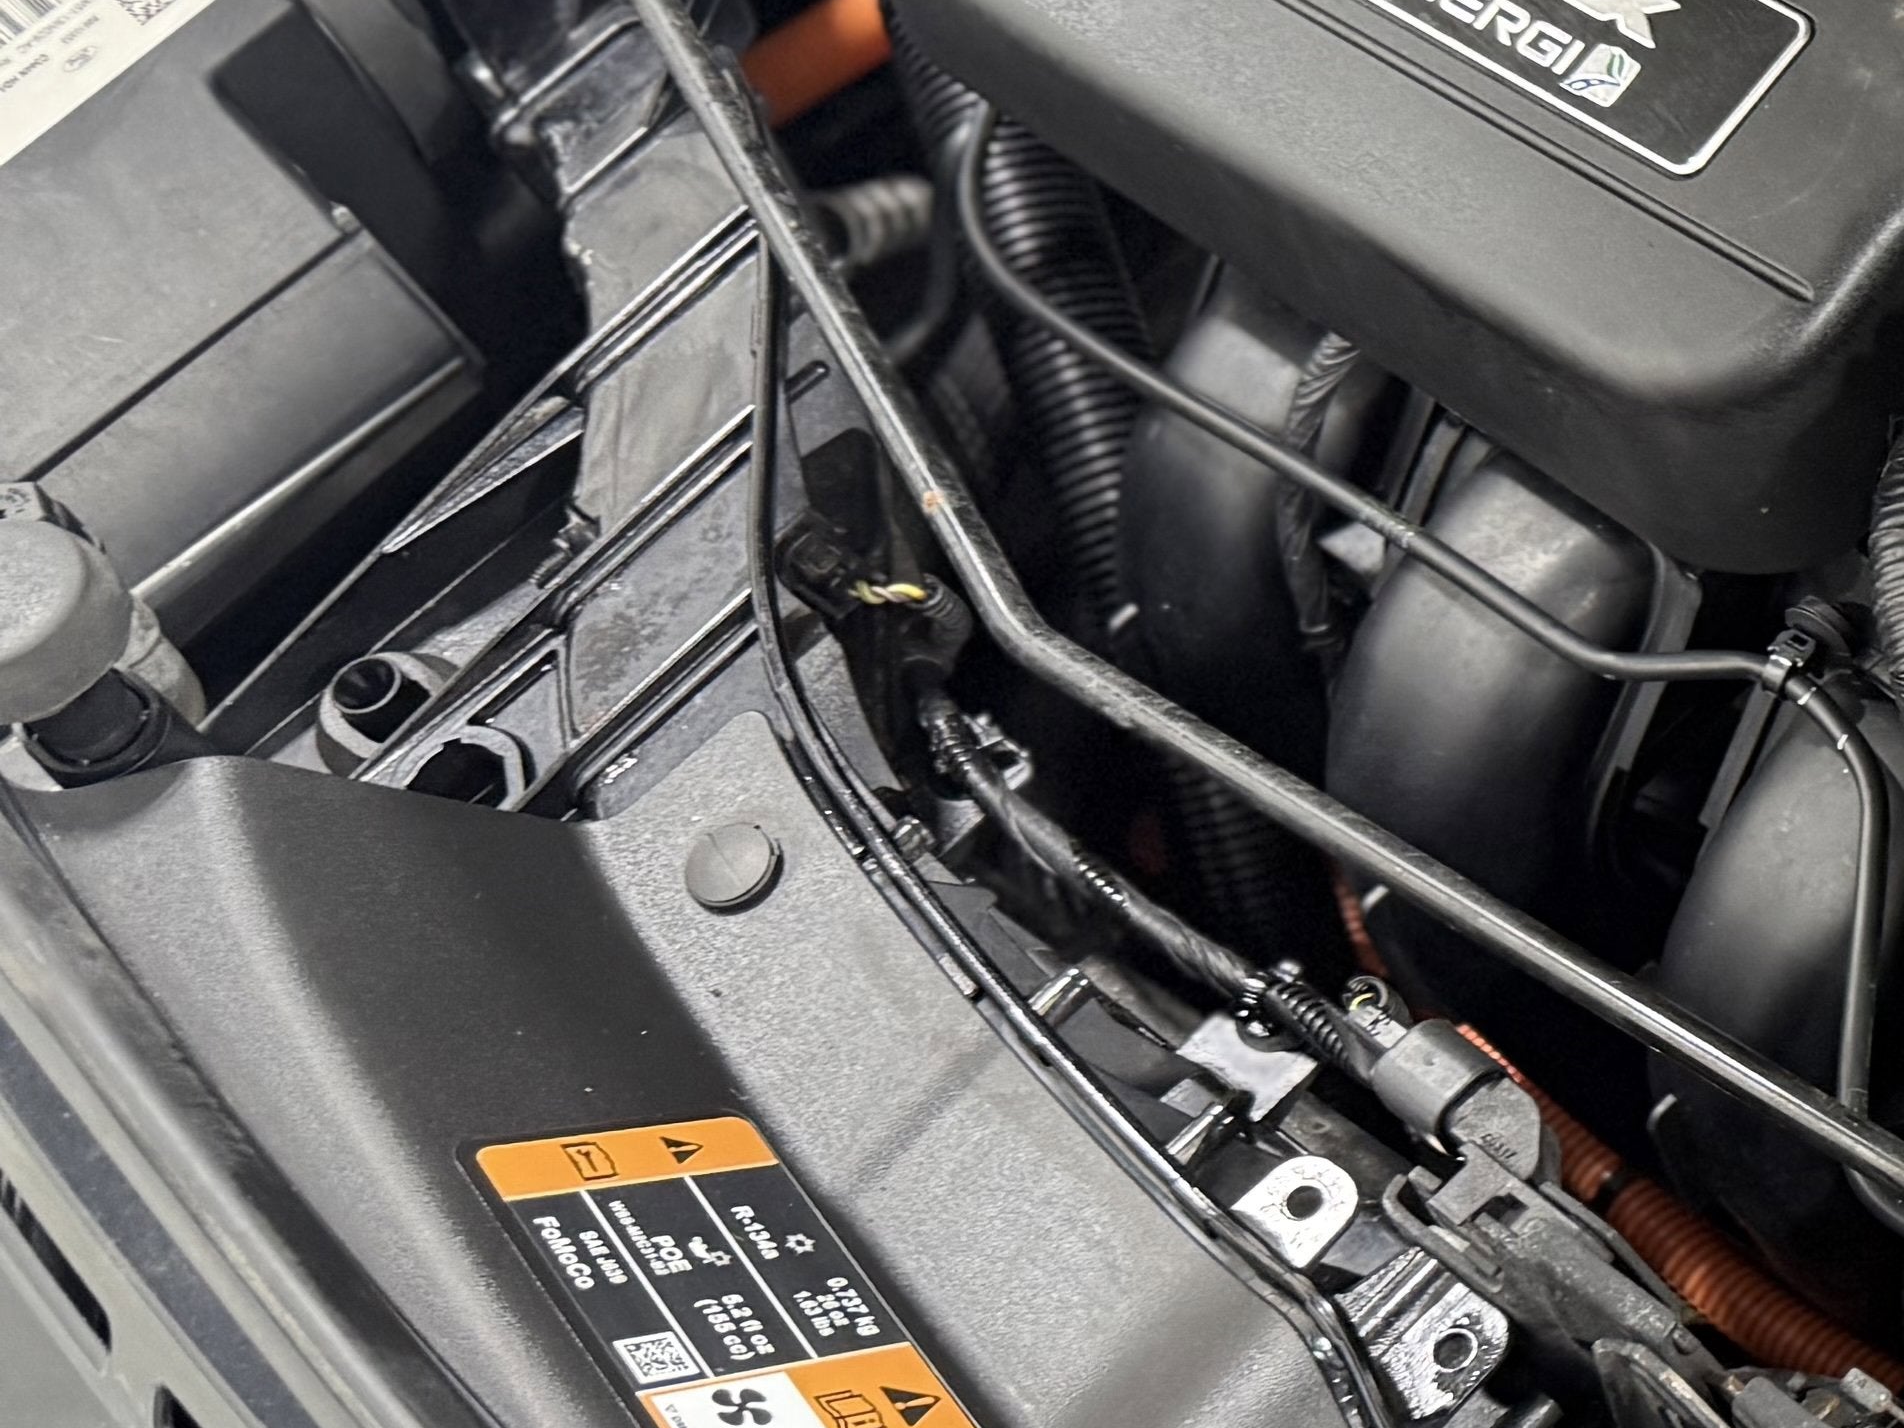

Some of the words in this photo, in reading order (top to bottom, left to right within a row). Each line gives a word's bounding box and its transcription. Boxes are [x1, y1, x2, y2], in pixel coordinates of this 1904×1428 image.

[532, 1216, 595, 1290] FoMoCo
[650, 1234, 693, 1274] POE
[730, 1205, 780, 1260] R-134a
[826, 1277, 870, 1314] 0.737
[855, 1315, 881, 1338] kg
